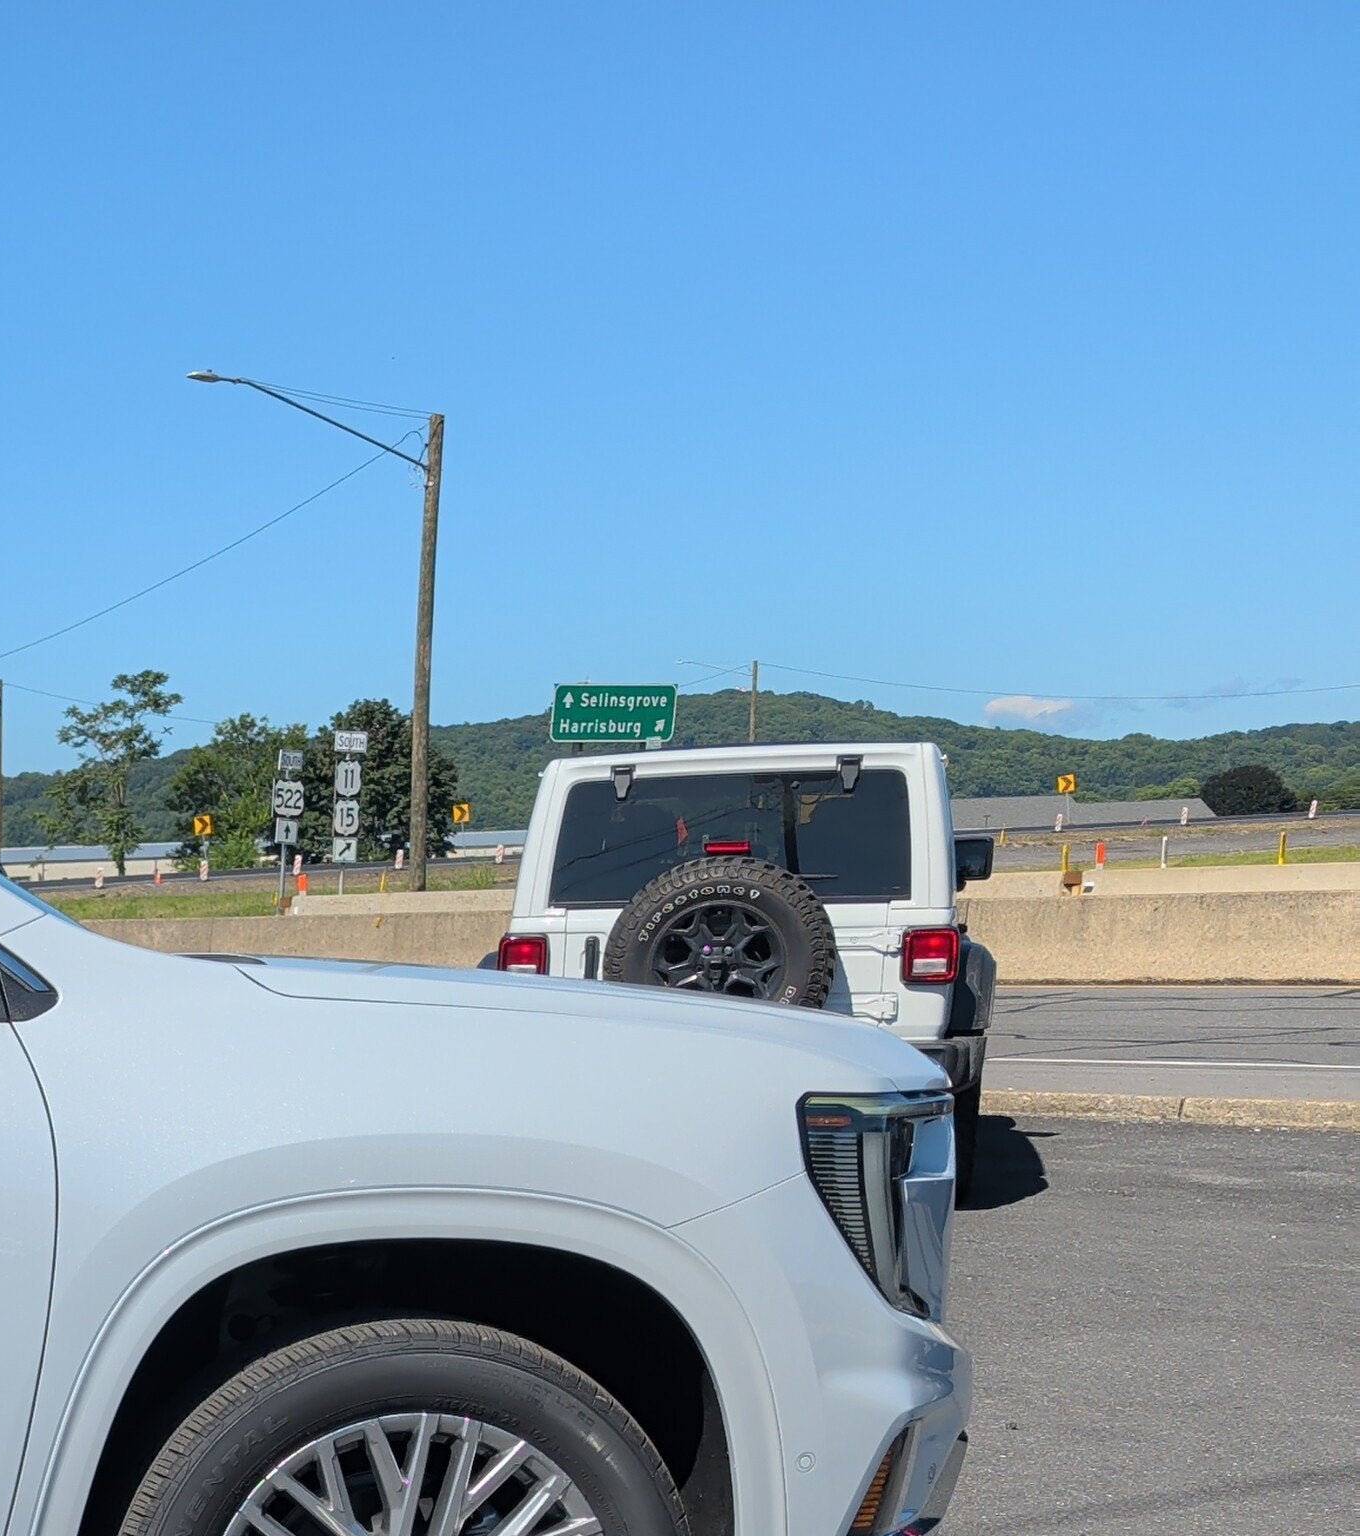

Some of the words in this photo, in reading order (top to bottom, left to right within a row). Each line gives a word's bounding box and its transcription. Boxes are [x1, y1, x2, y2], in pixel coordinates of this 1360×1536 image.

[580, 692, 668, 712] Selinsgrove
[559, 718, 641, 738] Harrisburg
[338, 735, 365, 749] SOUTH
[344, 768, 355, 789] 11
[275, 788, 302, 810] 522
[340, 807, 355, 828] 15
